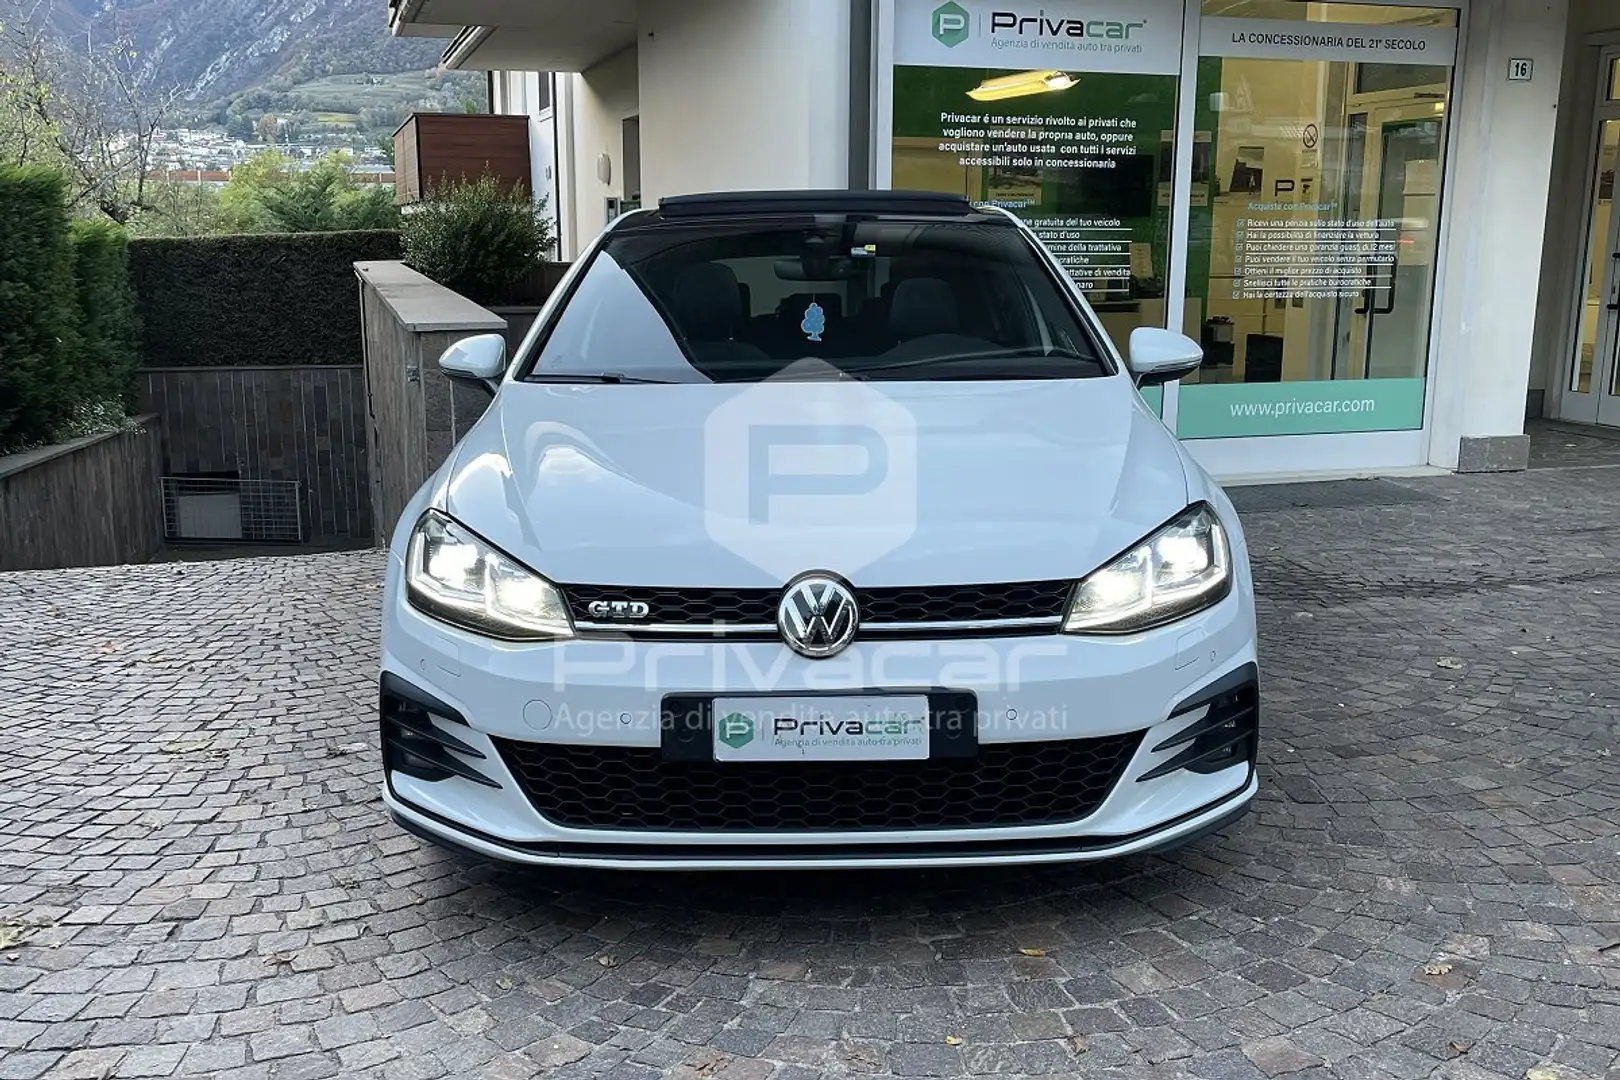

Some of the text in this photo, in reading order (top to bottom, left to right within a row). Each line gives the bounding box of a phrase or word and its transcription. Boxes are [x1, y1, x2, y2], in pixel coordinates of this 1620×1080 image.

[940, 9, 1144, 39] P Privacar
[991, 38, 1142, 54] Agenzia di vendita auto tra privati
[1232, 32, 1246, 43] LA
[1248, 33, 1344, 48] CONCESSIONARIA
[1346, 38, 1366, 48] DEL
[1384, 39, 1426, 50] SECOLO
[1514, 62, 1527, 76] 16
[940, 112, 981, 122] Privacar
[991, 116, 1004, 124] un
[1006, 115, 1043, 125] servizio
[1046, 116, 1076, 126] rivolto
[1078, 116, 1086, 126] ai
[1088, 118, 1118, 128] privati
[1120, 118, 1136, 128] che
[942, 127, 1134, 142] vogliono vendere la propria auto, oppure
[938, 142, 990, 152] acquistare
[992, 142, 1028, 152] un'auto
[1030, 144, 1056, 153] usata
[1060, 146, 1078, 154] con
[1080, 145, 1099, 154] tutti
[1106, 146, 1136, 155] servizi
[958, 156, 1116, 168] accessibili solo in concessionaria
[1034, 218, 1064, 228] gratuita
[1066, 218, 1078, 226] del
[1094, 218, 1120, 226] veicolo
[1103, 268, 1131, 276] vendita
[1230, 398, 1374, 418] www.privacar.com
[588, 600, 649, 618] GTD
[726, 715, 922, 739] P Privacar
[774, 737, 922, 748] Agenzia di vendita auto tra privati
